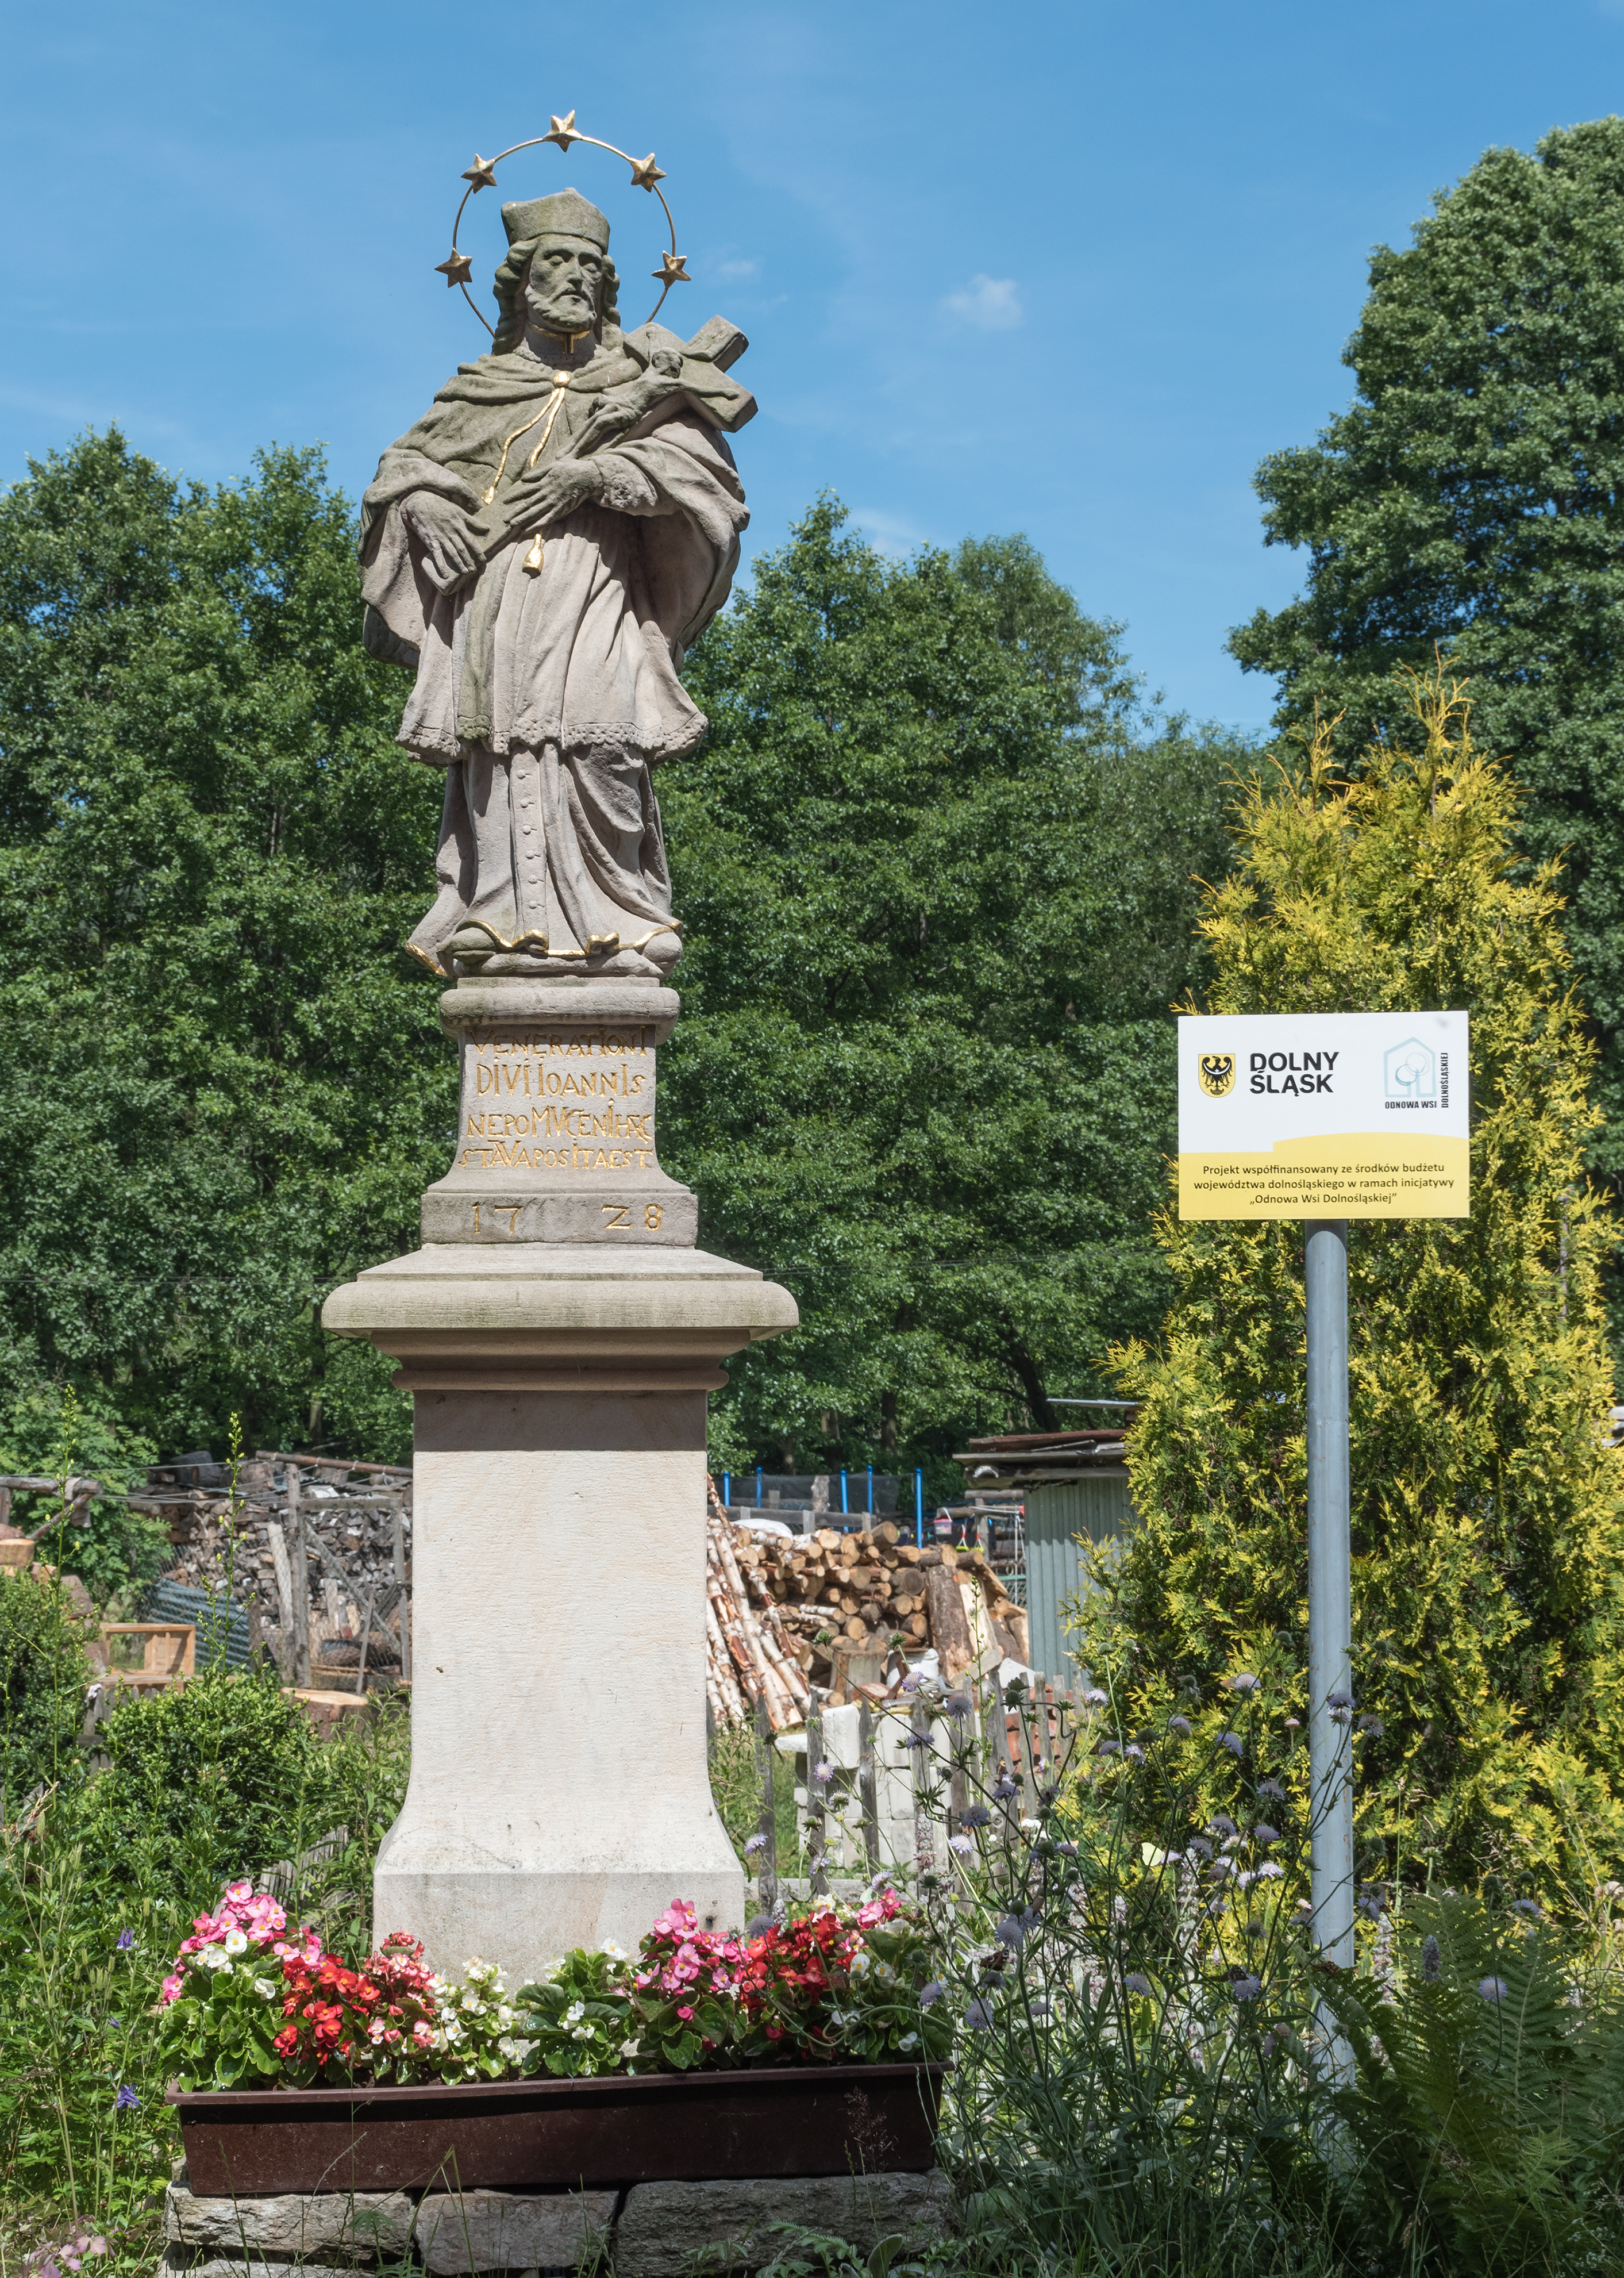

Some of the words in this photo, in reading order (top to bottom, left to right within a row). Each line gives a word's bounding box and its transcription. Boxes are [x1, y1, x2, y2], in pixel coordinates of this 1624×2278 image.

[465, 1025, 648, 1058] VENERATIONI
[1250, 1051, 1340, 1072] DOLNY
[1249, 1070, 1334, 1097] ŚLĄSK
[1439, 1052, 1450, 1108] DOLNOŚLĄSKIEJ
[1384, 1101, 1419, 1109] ODNOWA
[1421, 1100, 1437, 1108] WSI
[1203, 1165, 1240, 1176] Projekt
[1242, 1165, 1338, 1176] współfinansowany
[1355, 1163, 1399, 1173] środków
[1402, 1163, 1445, 1172] budżetu
[1194, 1180, 1265, 1191] województwa
[1268, 1179, 1345, 1190] dolnośląskiego
[1360, 1178, 1398, 1188] ramach
[1400, 1178, 1454, 1189] inicjatywy
[1301, 1194, 1320, 1203] Wsi
